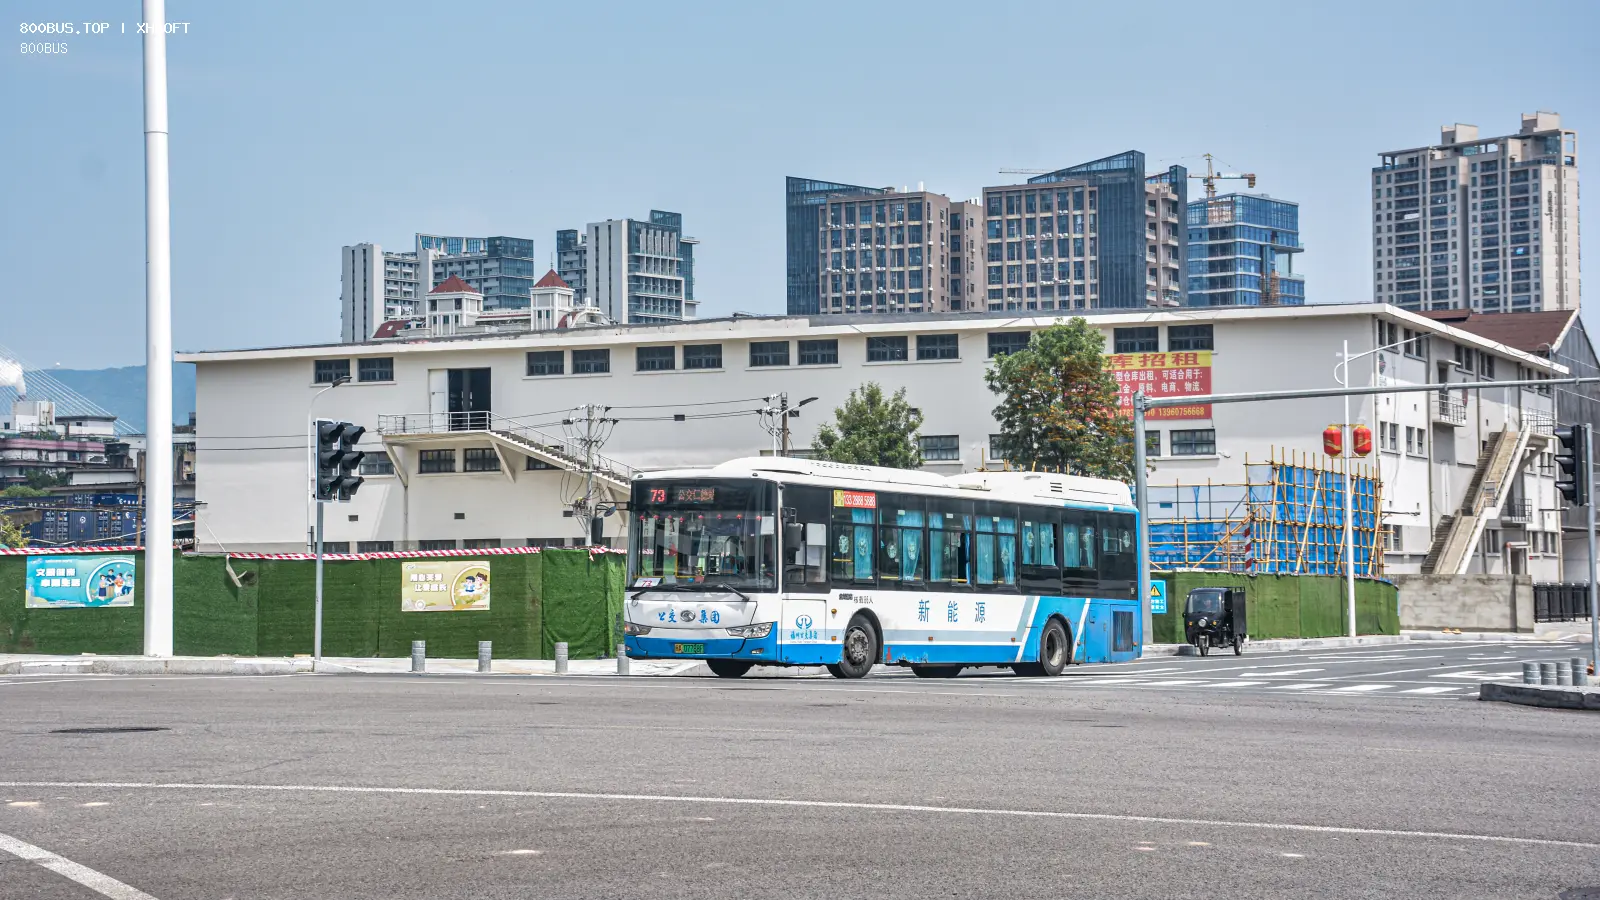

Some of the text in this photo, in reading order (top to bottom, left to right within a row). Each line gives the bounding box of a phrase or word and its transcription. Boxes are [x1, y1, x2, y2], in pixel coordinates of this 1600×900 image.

[650, 489, 665, 502] 73
[641, 579, 653, 587] 73
[917, 599, 986, 623] 新能源
